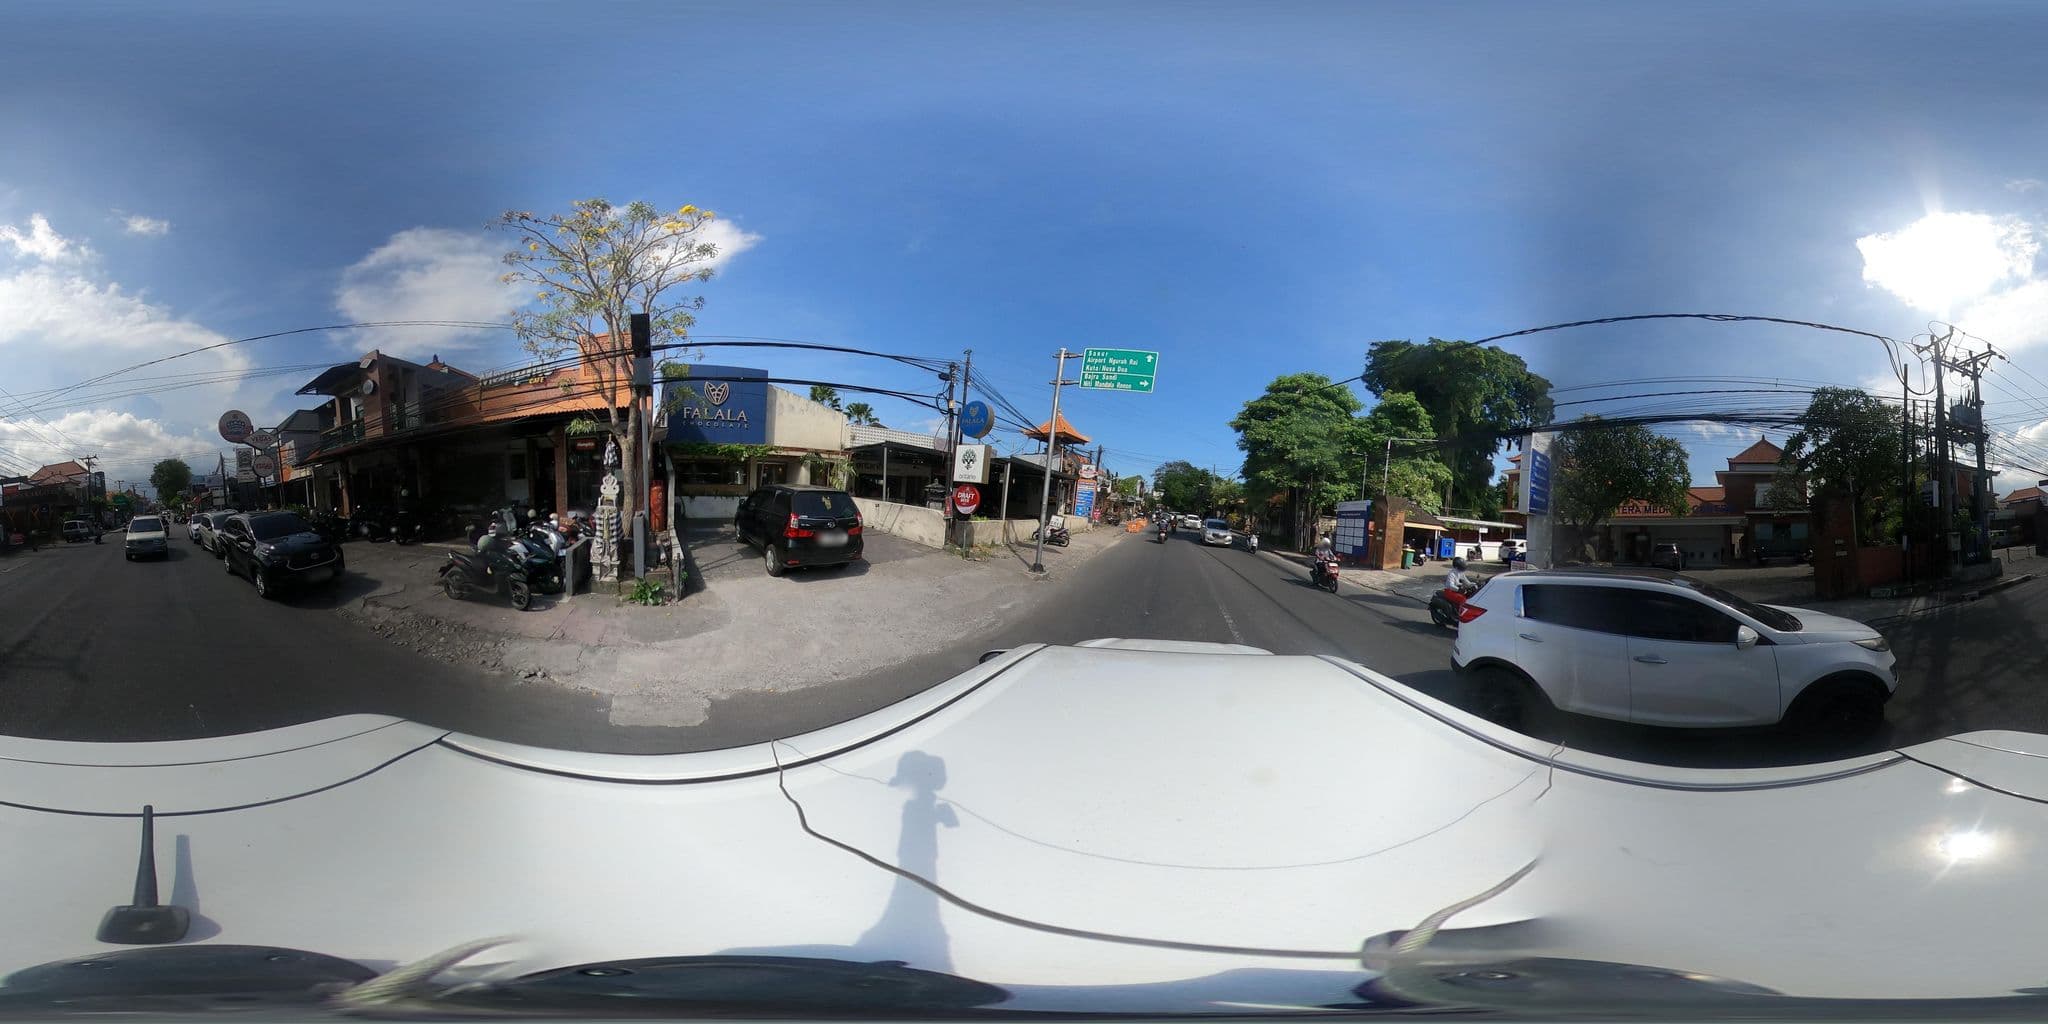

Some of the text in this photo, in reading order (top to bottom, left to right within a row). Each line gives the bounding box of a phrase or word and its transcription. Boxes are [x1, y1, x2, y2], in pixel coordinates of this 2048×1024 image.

[683, 407, 748, 422] FALALA
[683, 420, 749, 429] CHOCOLATE
[957, 492, 975, 500] DRAFT
